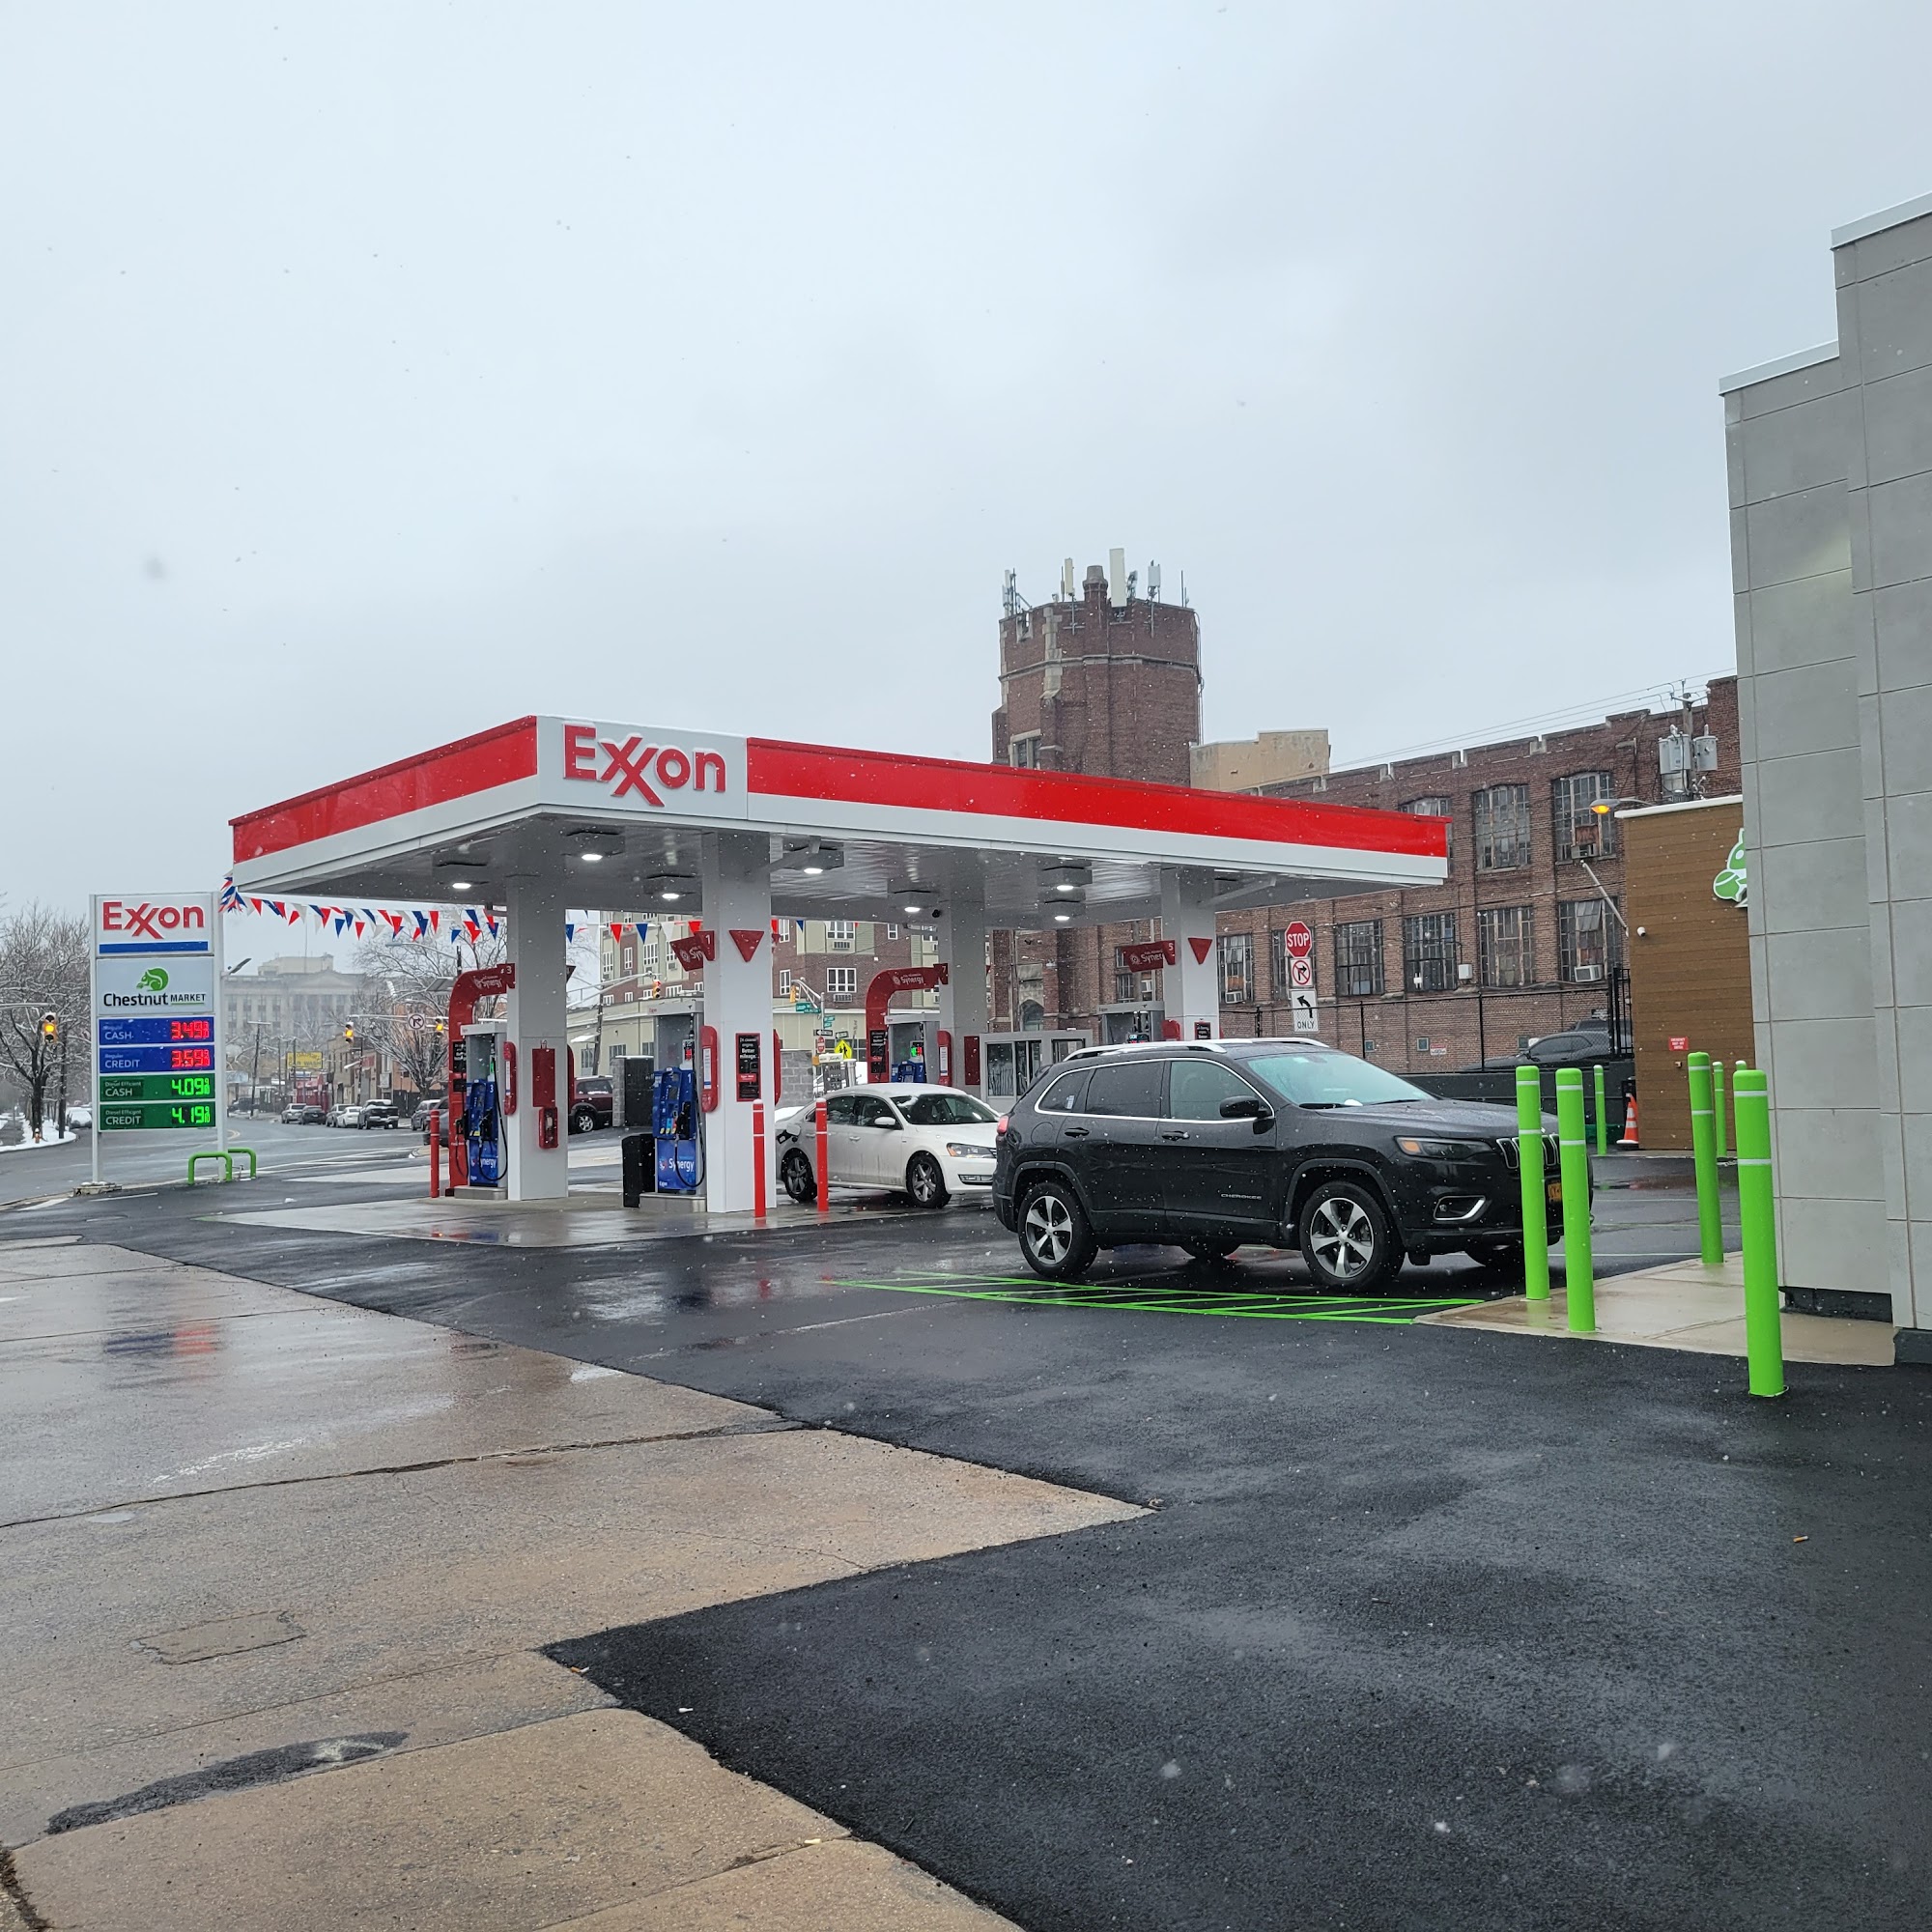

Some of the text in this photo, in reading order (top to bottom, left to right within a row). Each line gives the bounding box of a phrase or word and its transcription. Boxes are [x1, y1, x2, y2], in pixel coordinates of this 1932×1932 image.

[564, 724, 726, 808] Exxon
[102, 901, 205, 940] Exxon
[705, 935, 711, 945] 1
[1287, 933, 1310, 948] STOP
[506, 966, 512, 975] 3
[900, 976, 923, 985] Synergy
[103, 993, 168, 1007] Chestnut
[104, 1032, 132, 1040] CASH
[104, 1060, 140, 1068] CREDIT
[687, 1074, 692, 1083] 1
[104, 1088, 133, 1097] CASH
[490, 1085, 495, 1094] 3
[105, 1116, 142, 1125] CREDIT
[479, 1158, 497, 1169] ynergy
